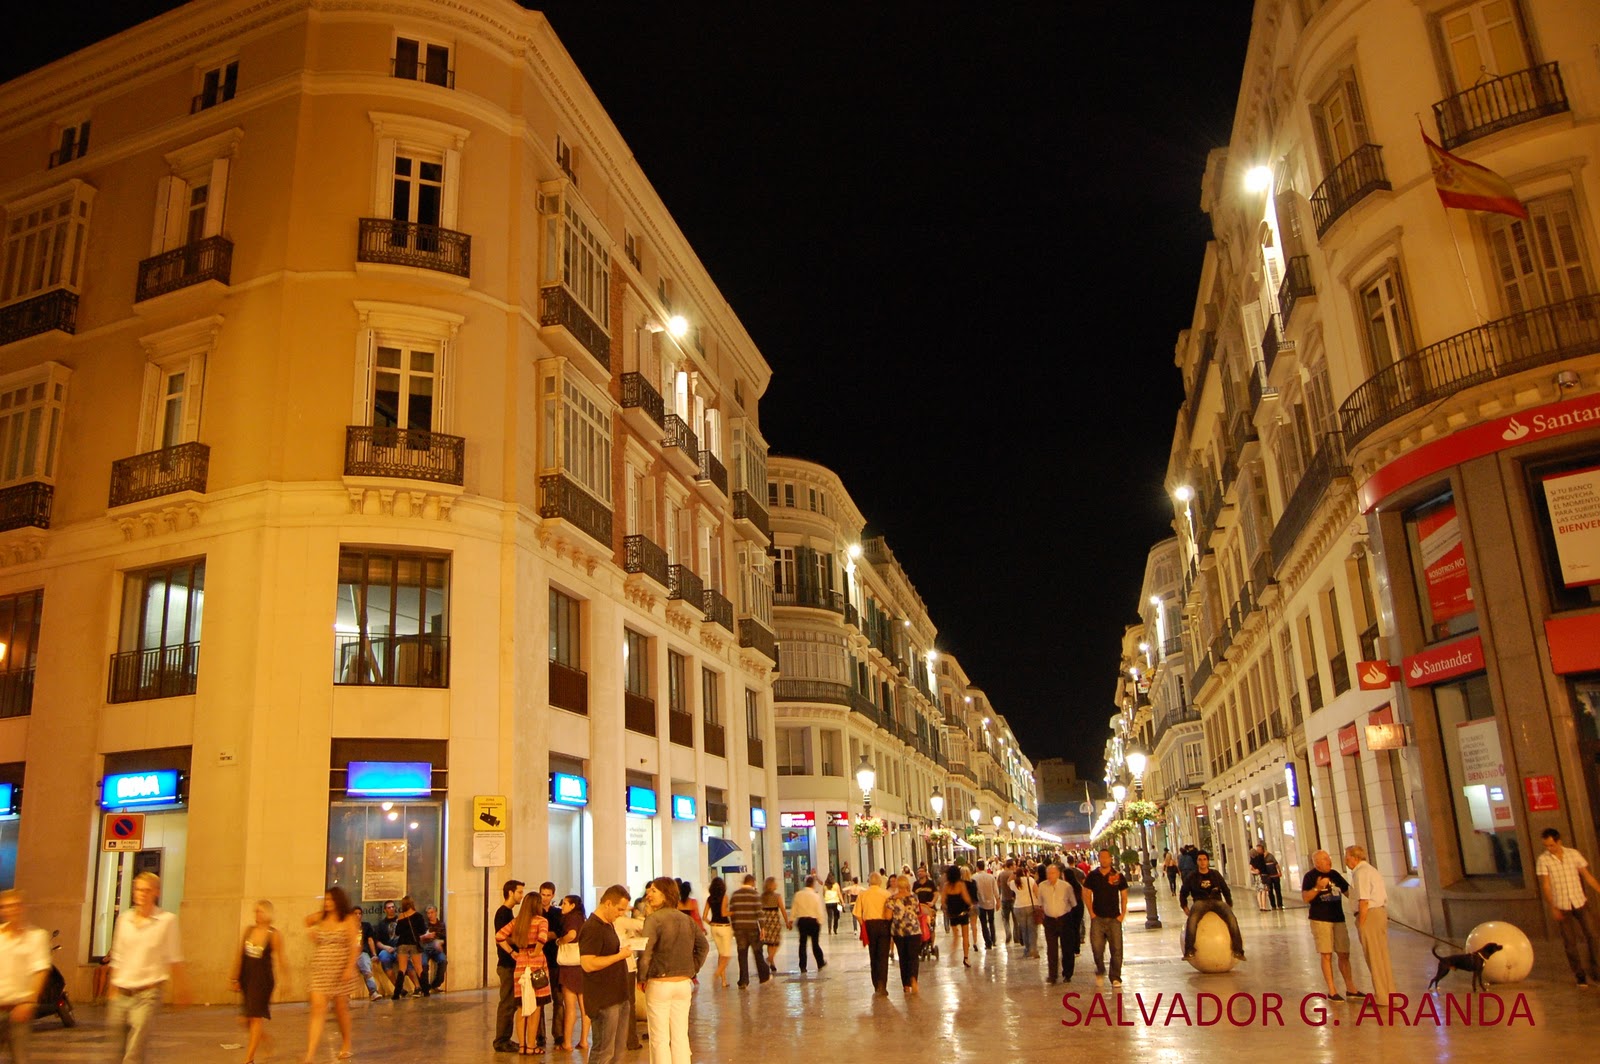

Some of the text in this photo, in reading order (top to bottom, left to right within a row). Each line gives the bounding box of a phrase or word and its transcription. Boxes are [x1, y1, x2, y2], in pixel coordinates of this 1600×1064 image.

[1568, 483, 1593, 492] BANCO
[1552, 491, 1594, 502] APROVECHA
[1562, 496, 1600, 508] MOMENTO
[1555, 509, 1573, 517] PARA
[1556, 511, 1600, 524] LAS COMISIO
[1454, 557, 1466, 569] NO
[1423, 650, 1473, 675] Santander
